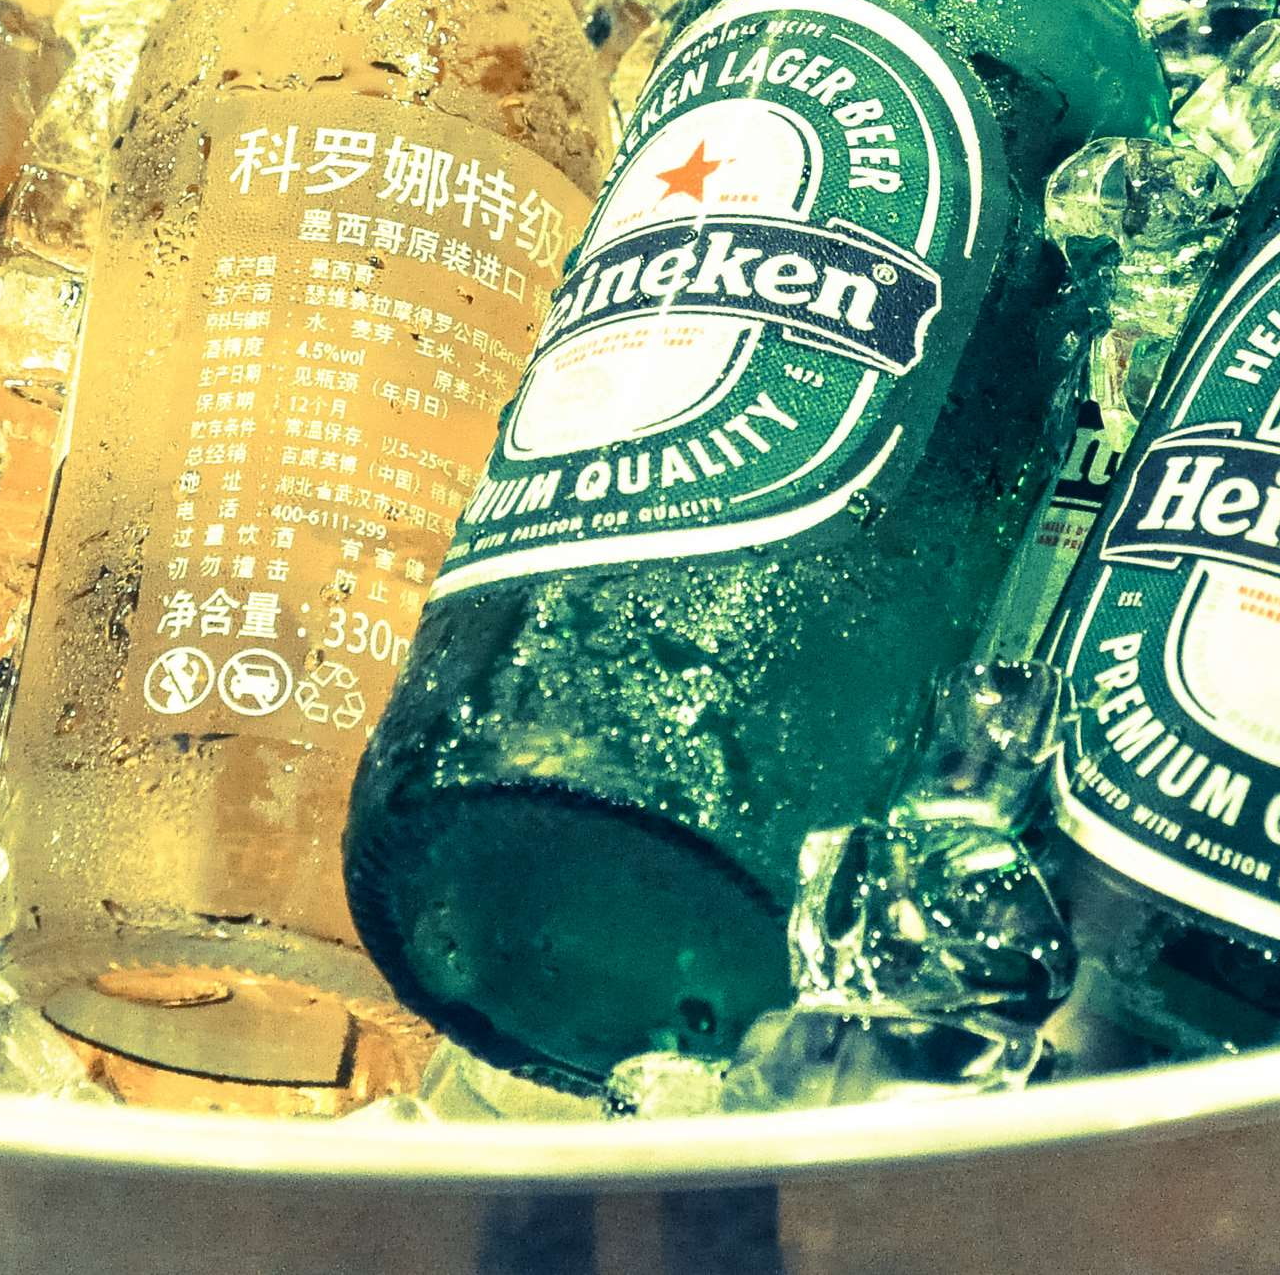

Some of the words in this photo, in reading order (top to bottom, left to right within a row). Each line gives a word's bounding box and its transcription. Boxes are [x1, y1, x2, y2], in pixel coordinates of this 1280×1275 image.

[715, 46, 857, 106] LAGER
[831, 96, 903, 196] BEER
[229, 125, 566, 278] 科罗娜特级
[297, 209, 526, 305] 墨西哥原装进口
[295, 340, 367, 366] 4.5%vol
[572, 391, 799, 502] QUALITY
[270, 504, 388, 541] 400-6111-299
[1099, 630, 1251, 828] PREMIUM
[1185, 831, 1273, 883] PASSION
